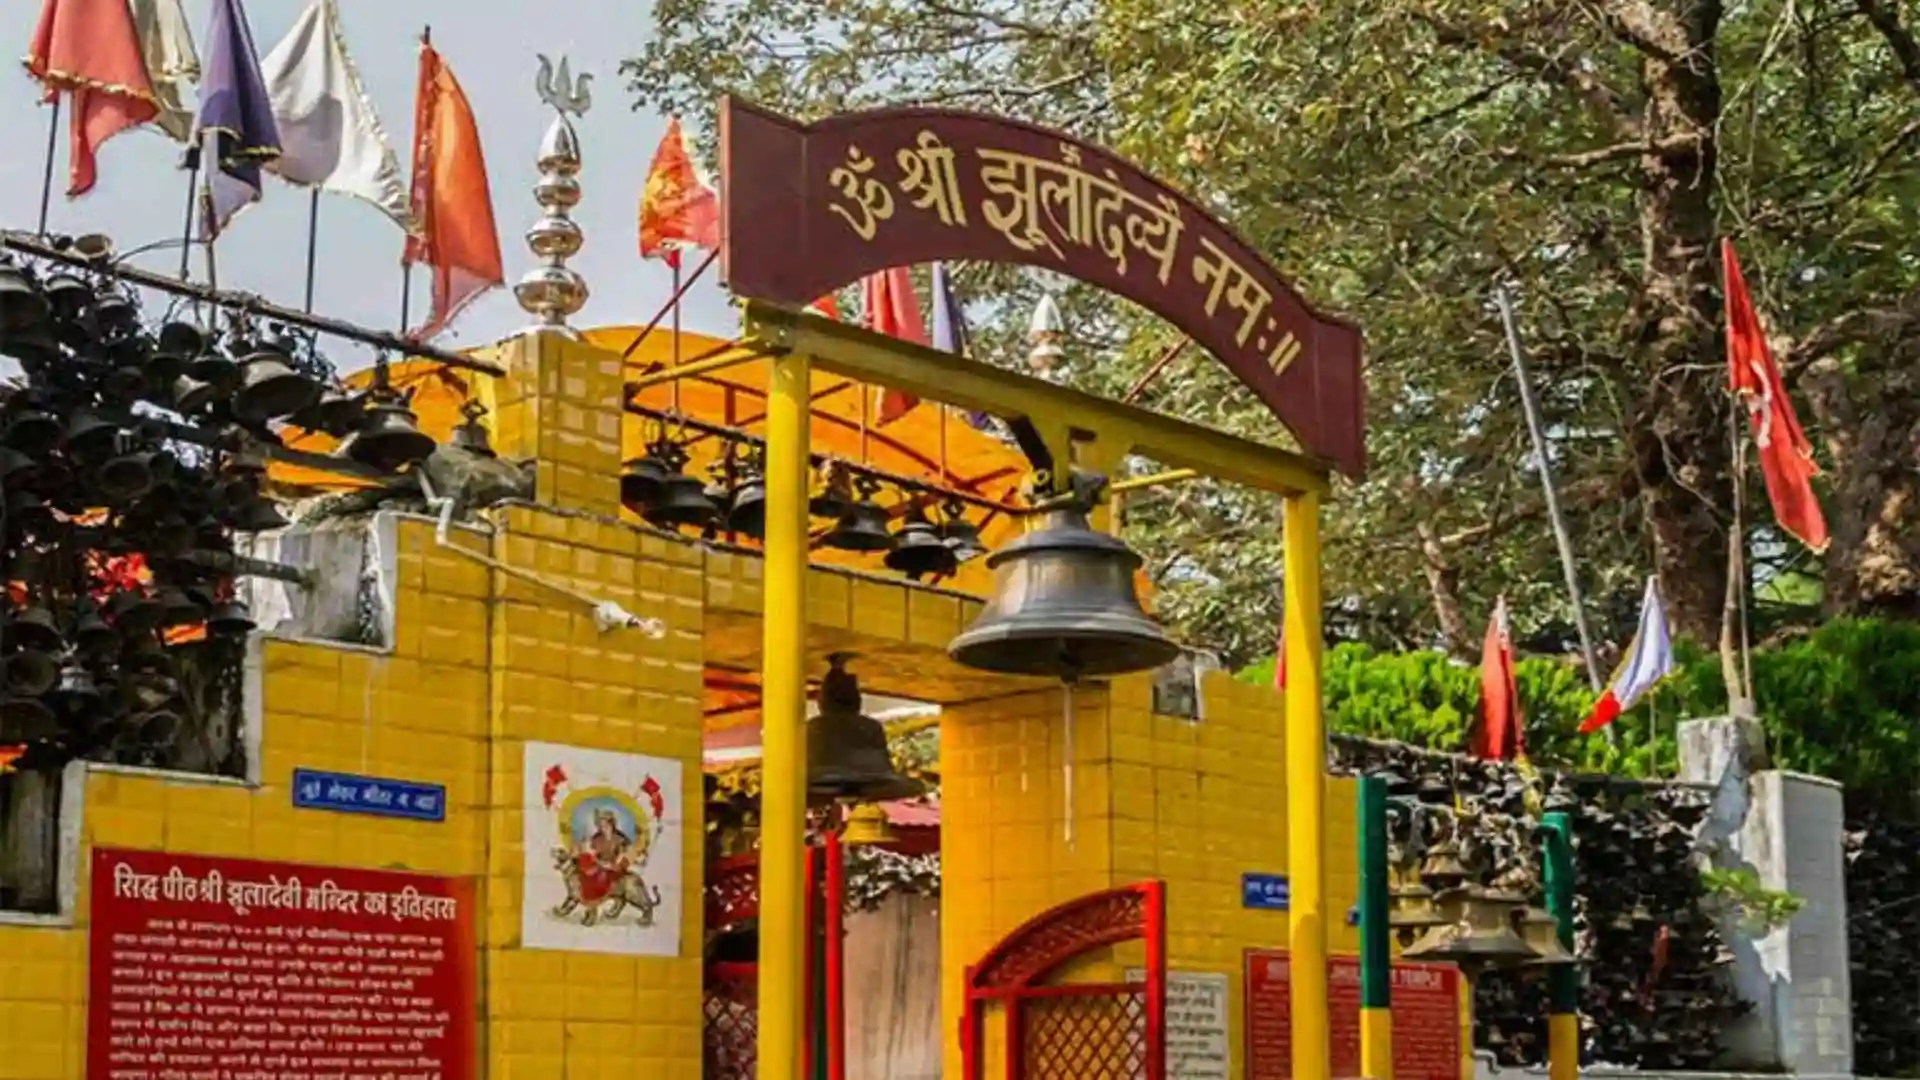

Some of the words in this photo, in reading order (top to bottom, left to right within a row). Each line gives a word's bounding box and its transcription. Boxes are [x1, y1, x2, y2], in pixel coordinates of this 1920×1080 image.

[828, 143, 895, 241] ॐ
[896, 129, 968, 228] श्री
[113, 861, 160, 901] सिद्ध
[162, 865, 198, 902] पीठ
[199, 869, 223, 904] श्री
[226, 873, 301, 916] झूलादेवी
[363, 891, 388, 916] का
[390, 884, 457, 922] इतिहास
